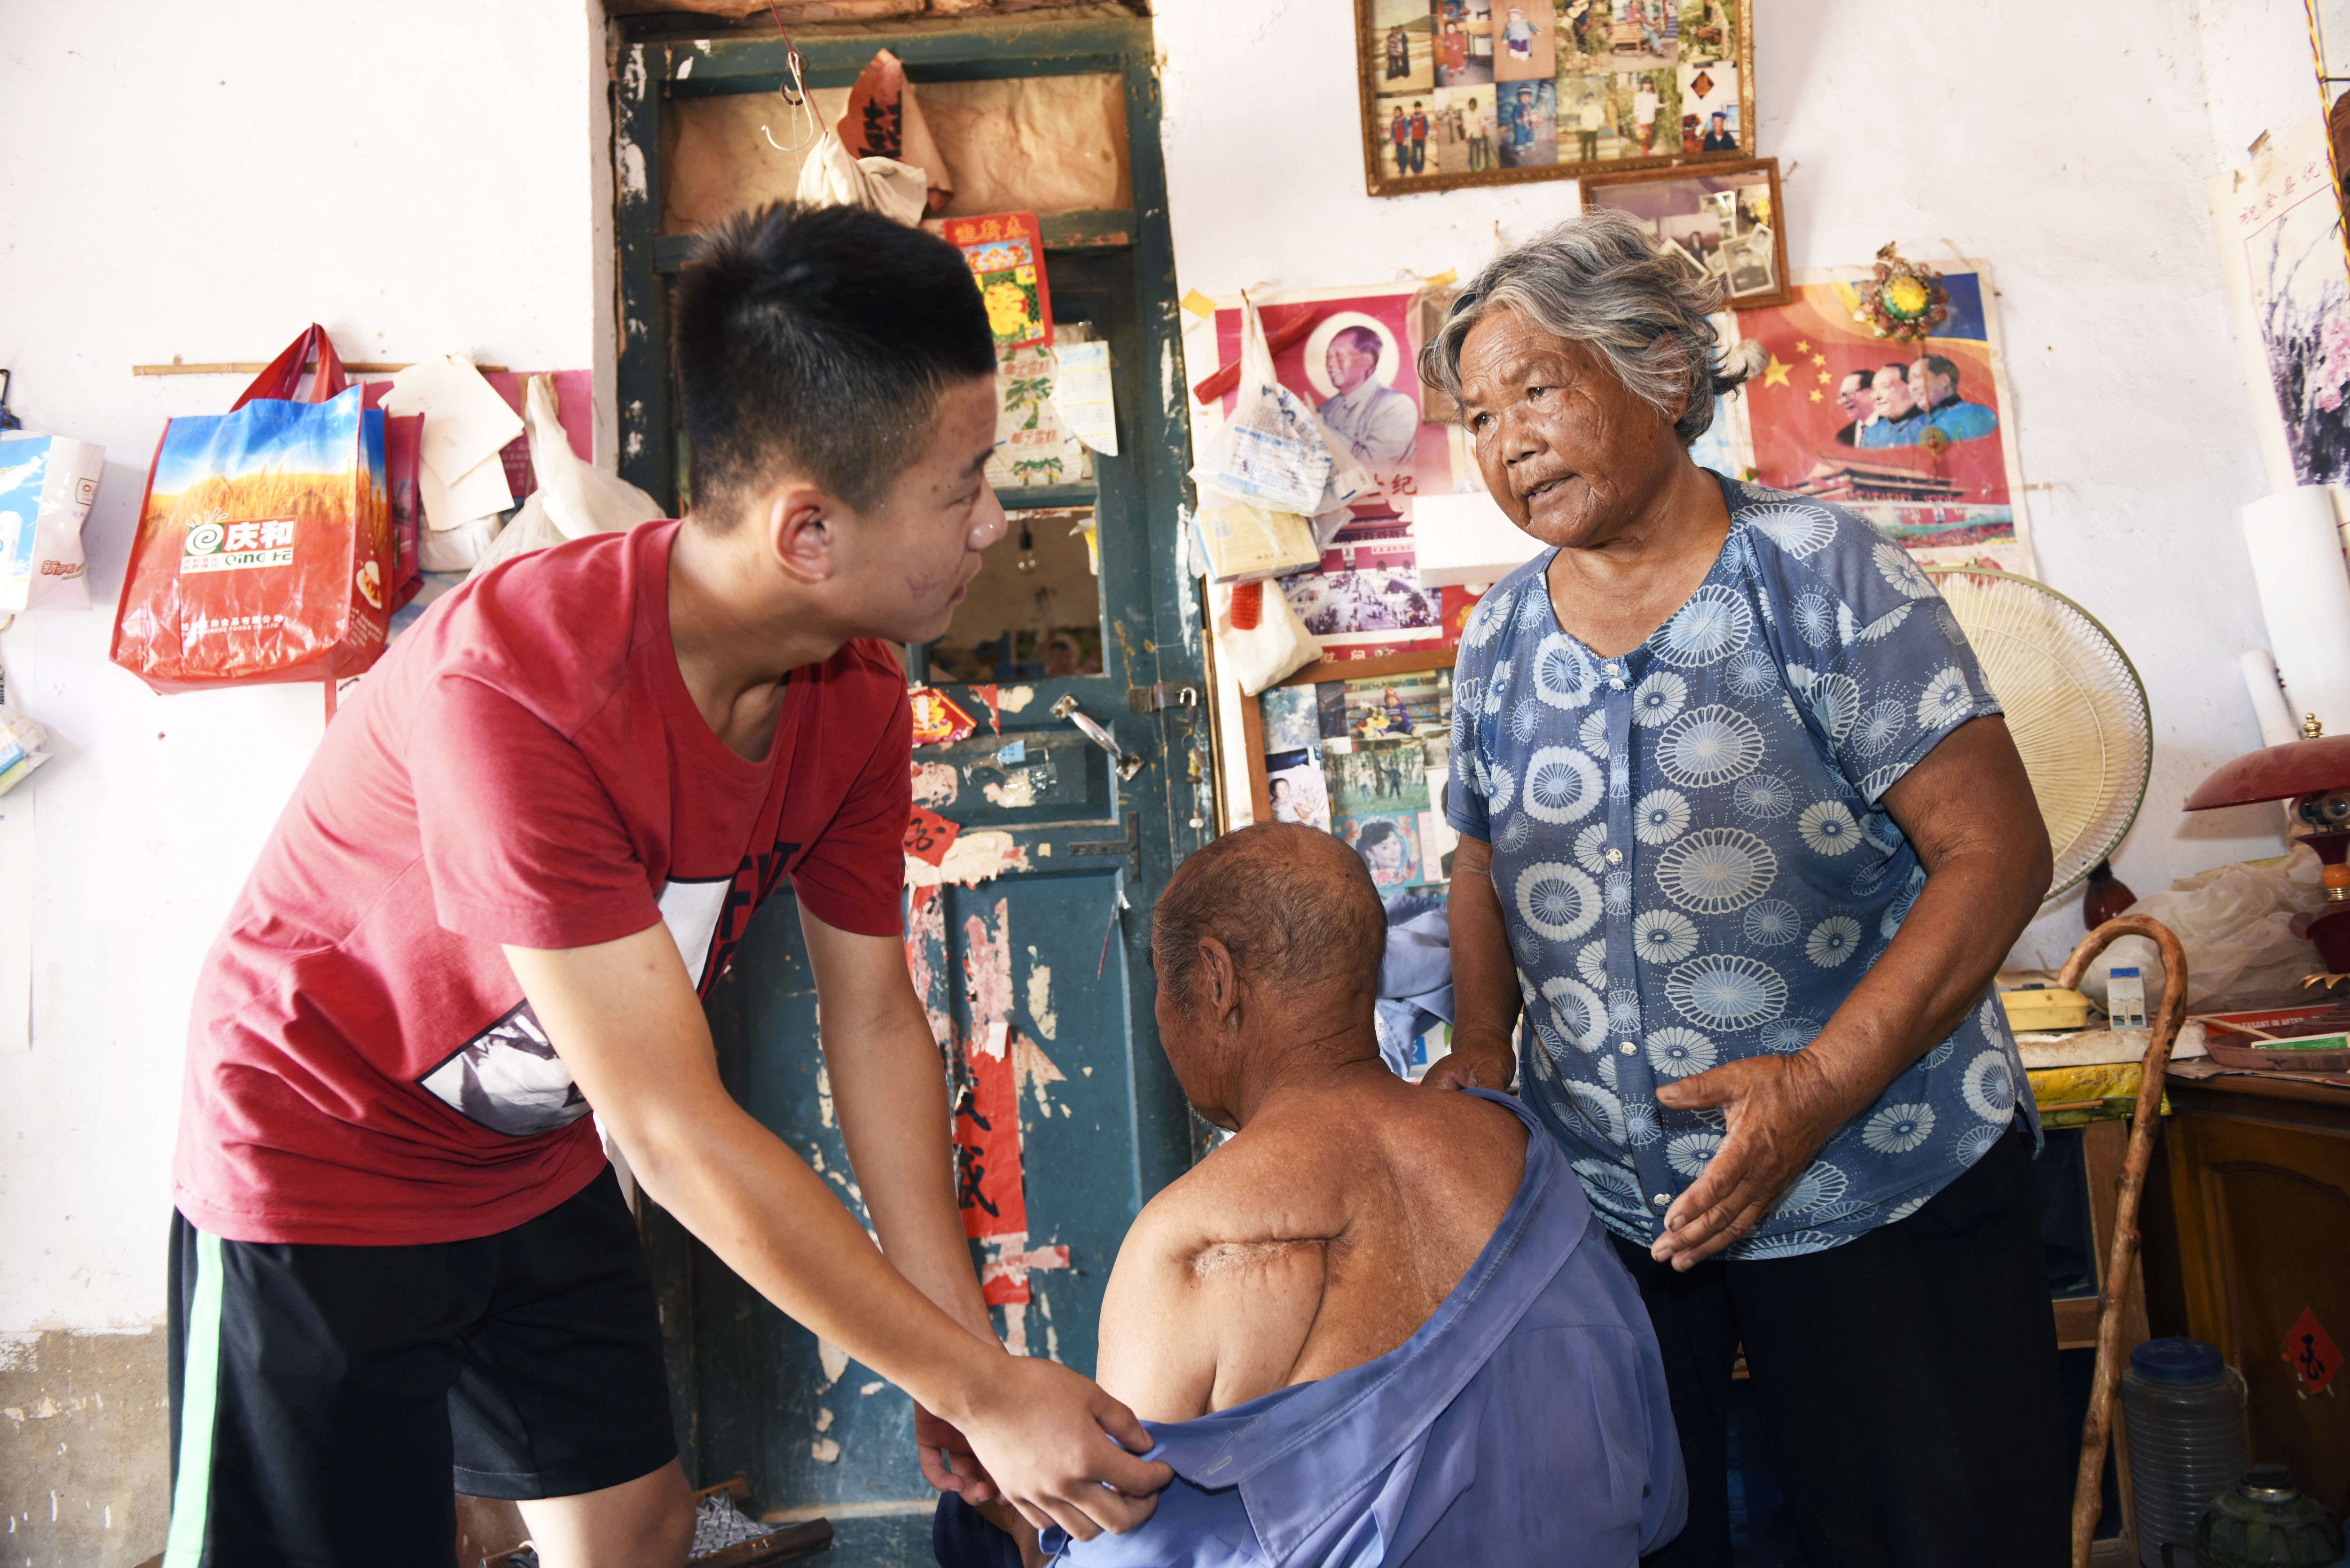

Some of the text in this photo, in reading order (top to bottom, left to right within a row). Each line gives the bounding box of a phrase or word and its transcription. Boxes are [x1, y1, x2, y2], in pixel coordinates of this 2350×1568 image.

[2240, 157, 2330, 226] 祝全县优
[224, 520, 295, 552] 庆和
[273, 550, 291, 561] HE
[181, 614, 284, 632] 桂和食品有限公司
